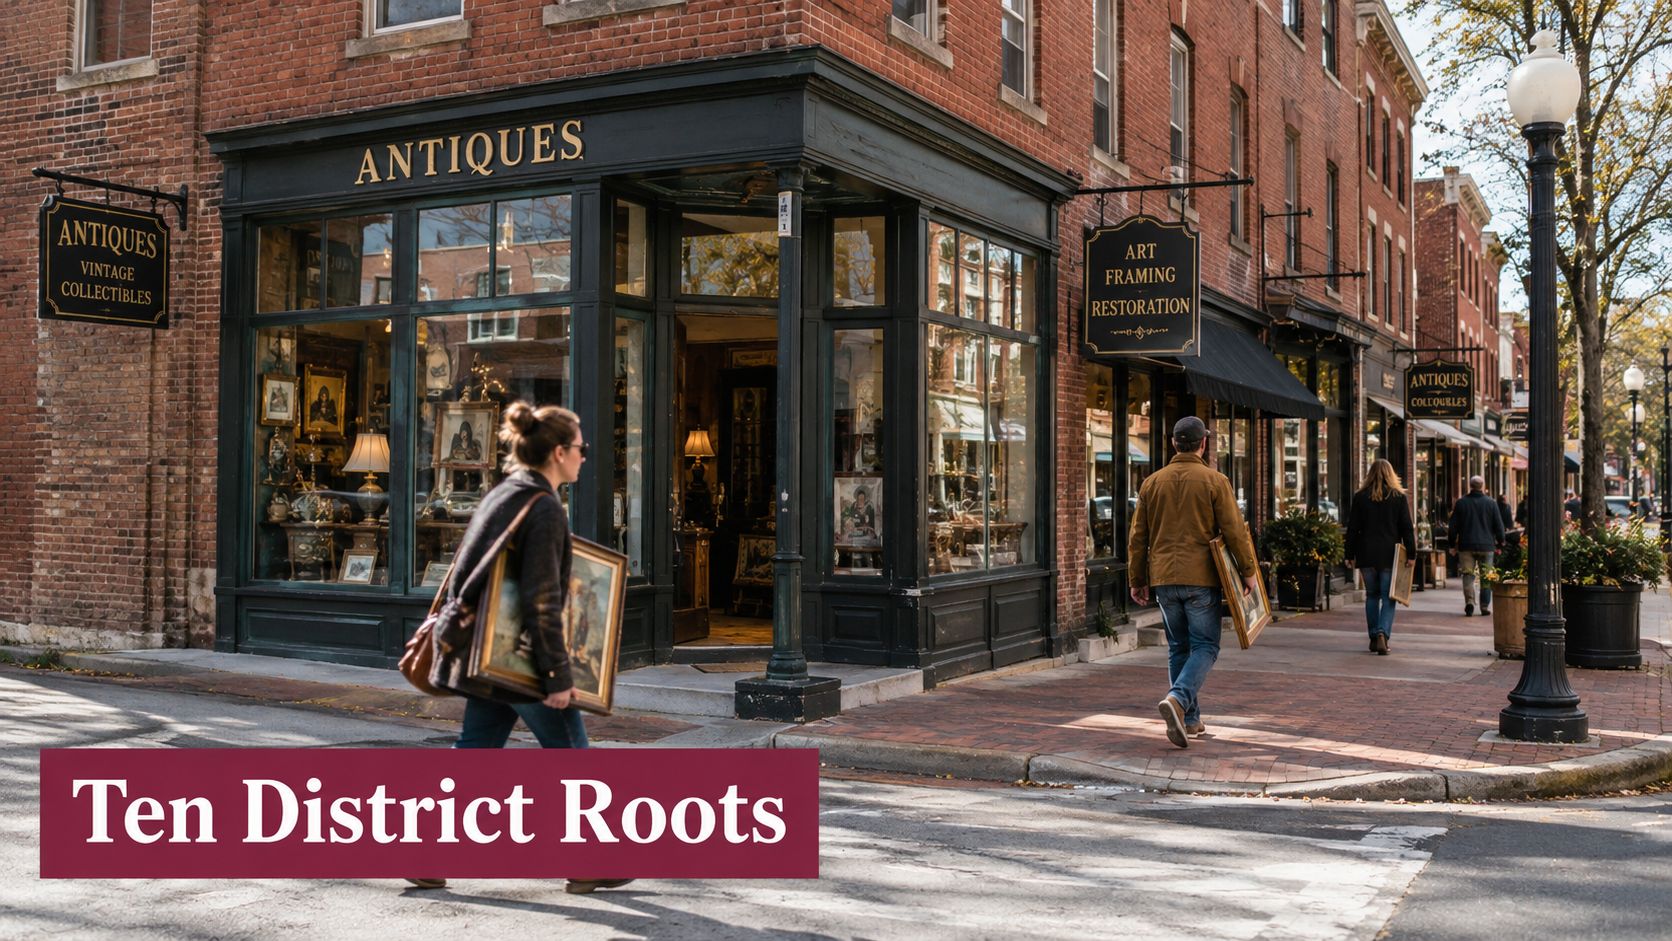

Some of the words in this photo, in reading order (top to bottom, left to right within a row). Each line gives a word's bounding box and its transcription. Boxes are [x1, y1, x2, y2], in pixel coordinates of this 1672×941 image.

[354, 119, 583, 185] ANTIQUES
[57, 219, 157, 259] ANTIQUES
[1125, 243, 1157, 260] ART
[80, 260, 135, 281] VINTAGE
[1105, 266, 1176, 285] FRAMING
[61, 280, 152, 305] COLLECTIBLES
[1092, 297, 1190, 317] RESTORATION
[1410, 372, 1468, 389] ANTIQUES
